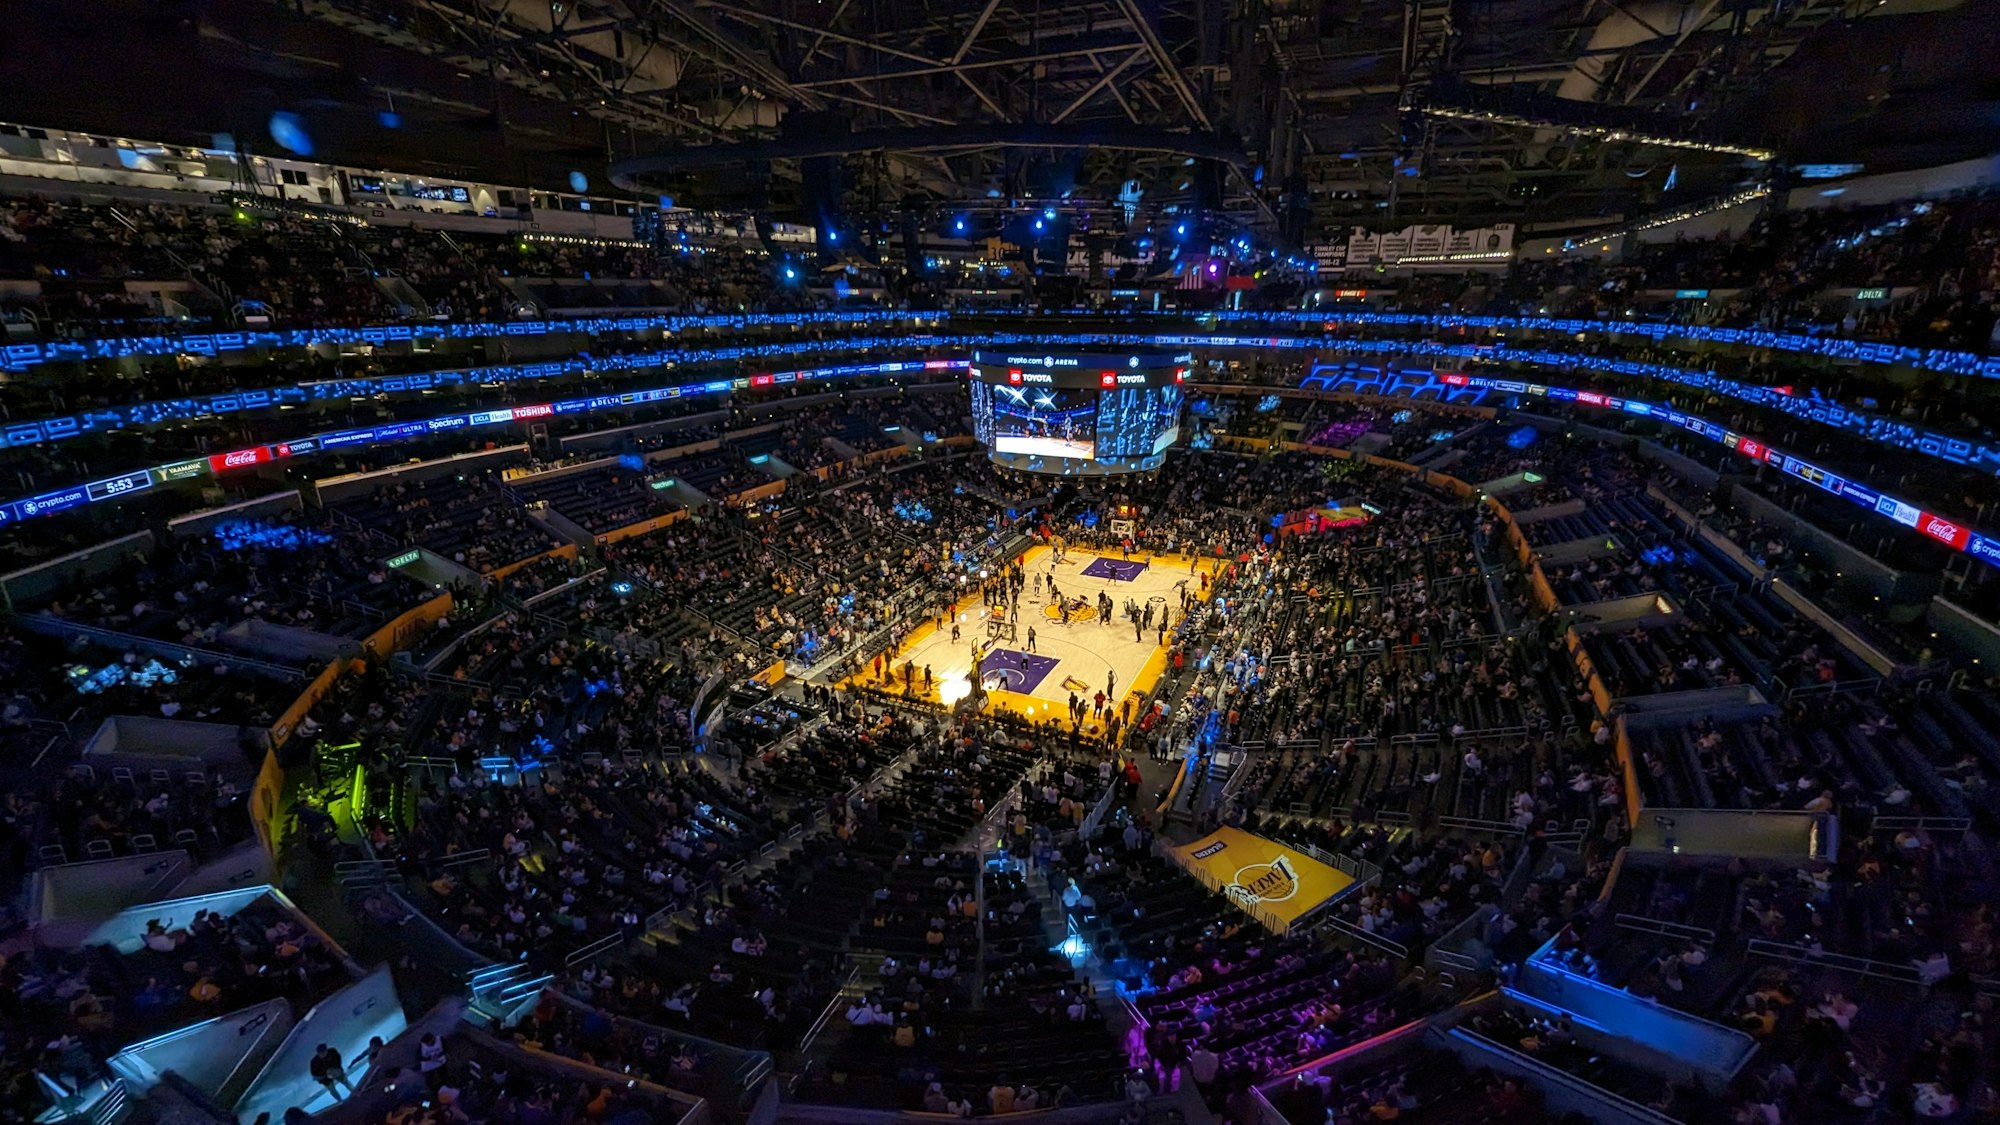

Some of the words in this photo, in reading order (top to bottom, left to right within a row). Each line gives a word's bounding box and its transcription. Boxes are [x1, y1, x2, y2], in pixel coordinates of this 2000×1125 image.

[1008, 357, 1043, 365] crypto.com
[1022, 373, 1052, 383] TOYOTA
[1117, 374, 1145, 384] TOYOTA
[597, 397, 620, 406] DELTA
[1578, 393, 1601, 404] TOSHIBA
[514, 406, 552, 418] TOSHIBA
[563, 401, 585, 411] crypto.com
[474, 414, 490, 423] UCLA
[491, 410, 511, 421] Health
[401, 424, 423, 433] ULTRA
[428, 417, 464, 430] Spectrum
[324, 435, 350, 445] AMERICAN
[350, 432, 373, 441] EXPRESS
[289, 441, 314, 451] TOYOTA
[225, 450, 257, 467] Coca-Cola
[106, 477, 134, 494] 5:53
[37, 491, 82, 510] crypto.com
[1881, 500, 1895, 513] UCLA
[1896, 506, 1916, 523] Health
[1926, 519, 1957, 542] Coca-Cola
[395, 552, 418, 566] DELTA
